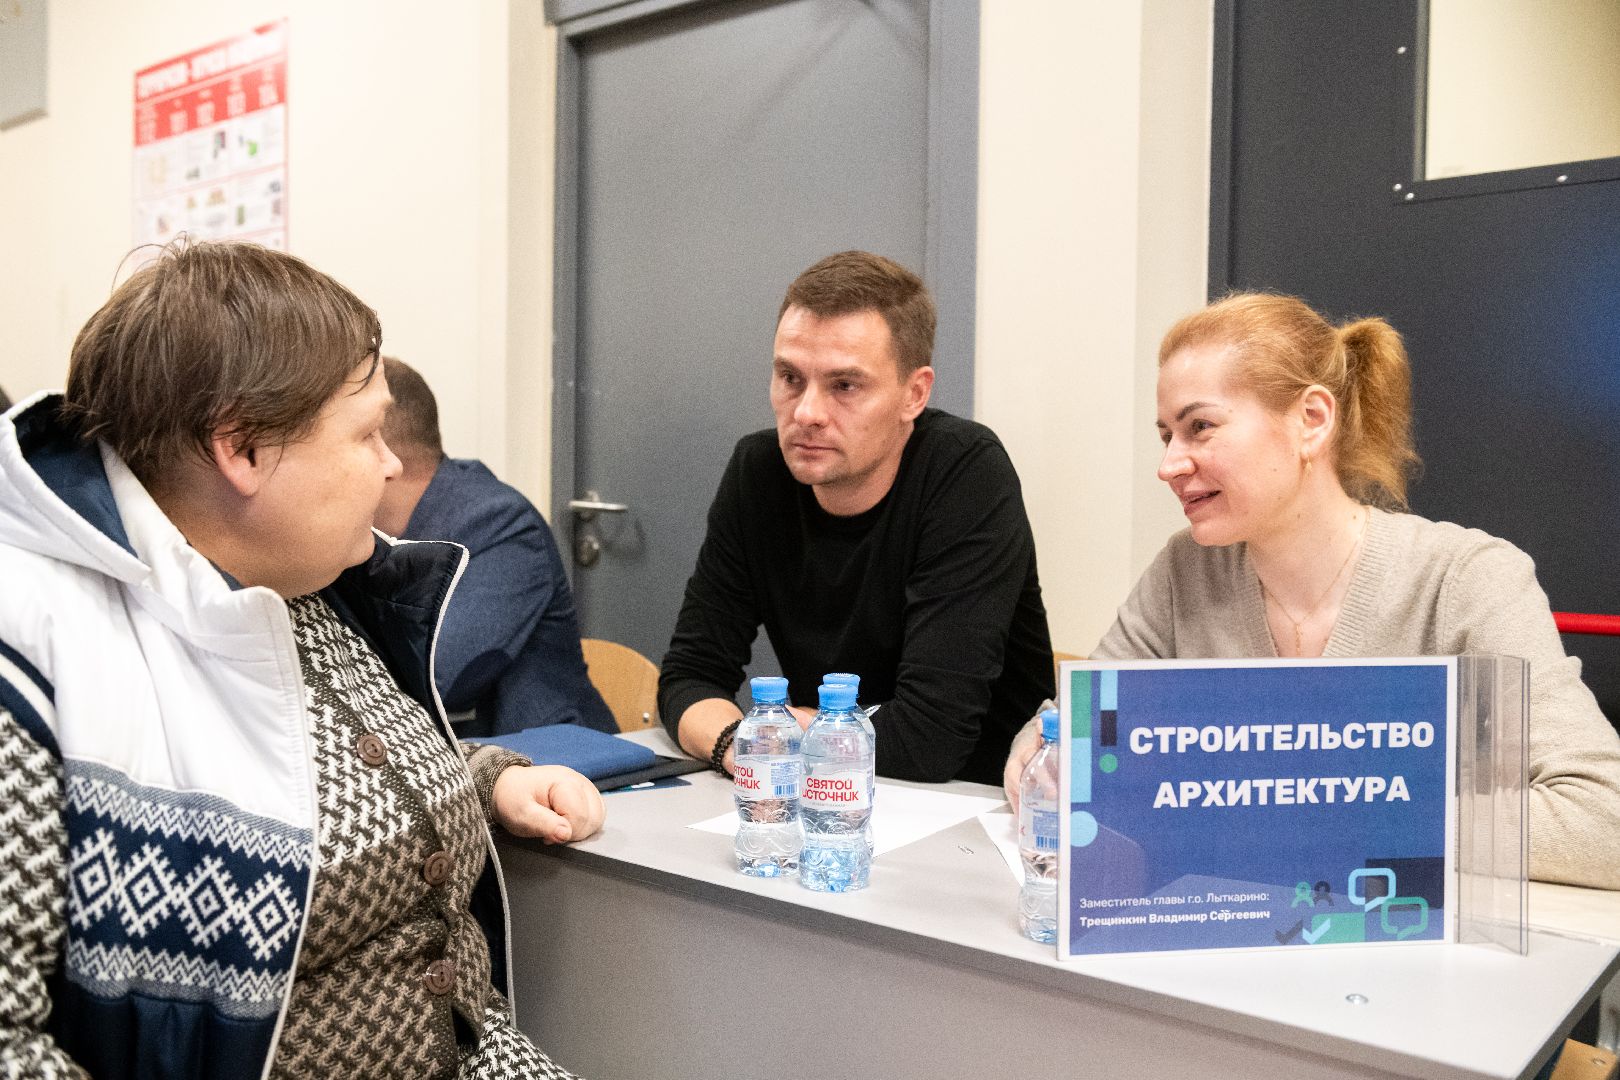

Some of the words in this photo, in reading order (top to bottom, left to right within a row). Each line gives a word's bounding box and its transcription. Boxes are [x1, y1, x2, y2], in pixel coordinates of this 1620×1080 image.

[1129, 721, 1435, 755] СТРОИТЕЛЬСТВО
[806, 777, 853, 790] СВЯТОЙ
[1153, 776, 1411, 809] АРХИТЕКТУРА
[1080, 897, 1152, 909] Заместитель
[1153, 895, 1186, 906] главы
[1187, 895, 1204, 905] г.о.
[1206, 893, 1270, 904] Лыткарино:
[1080, 915, 1147, 928] Трещинкин
[1149, 911, 1208, 924] Владимир
[1209, 909, 1271, 923] Сергеевич
